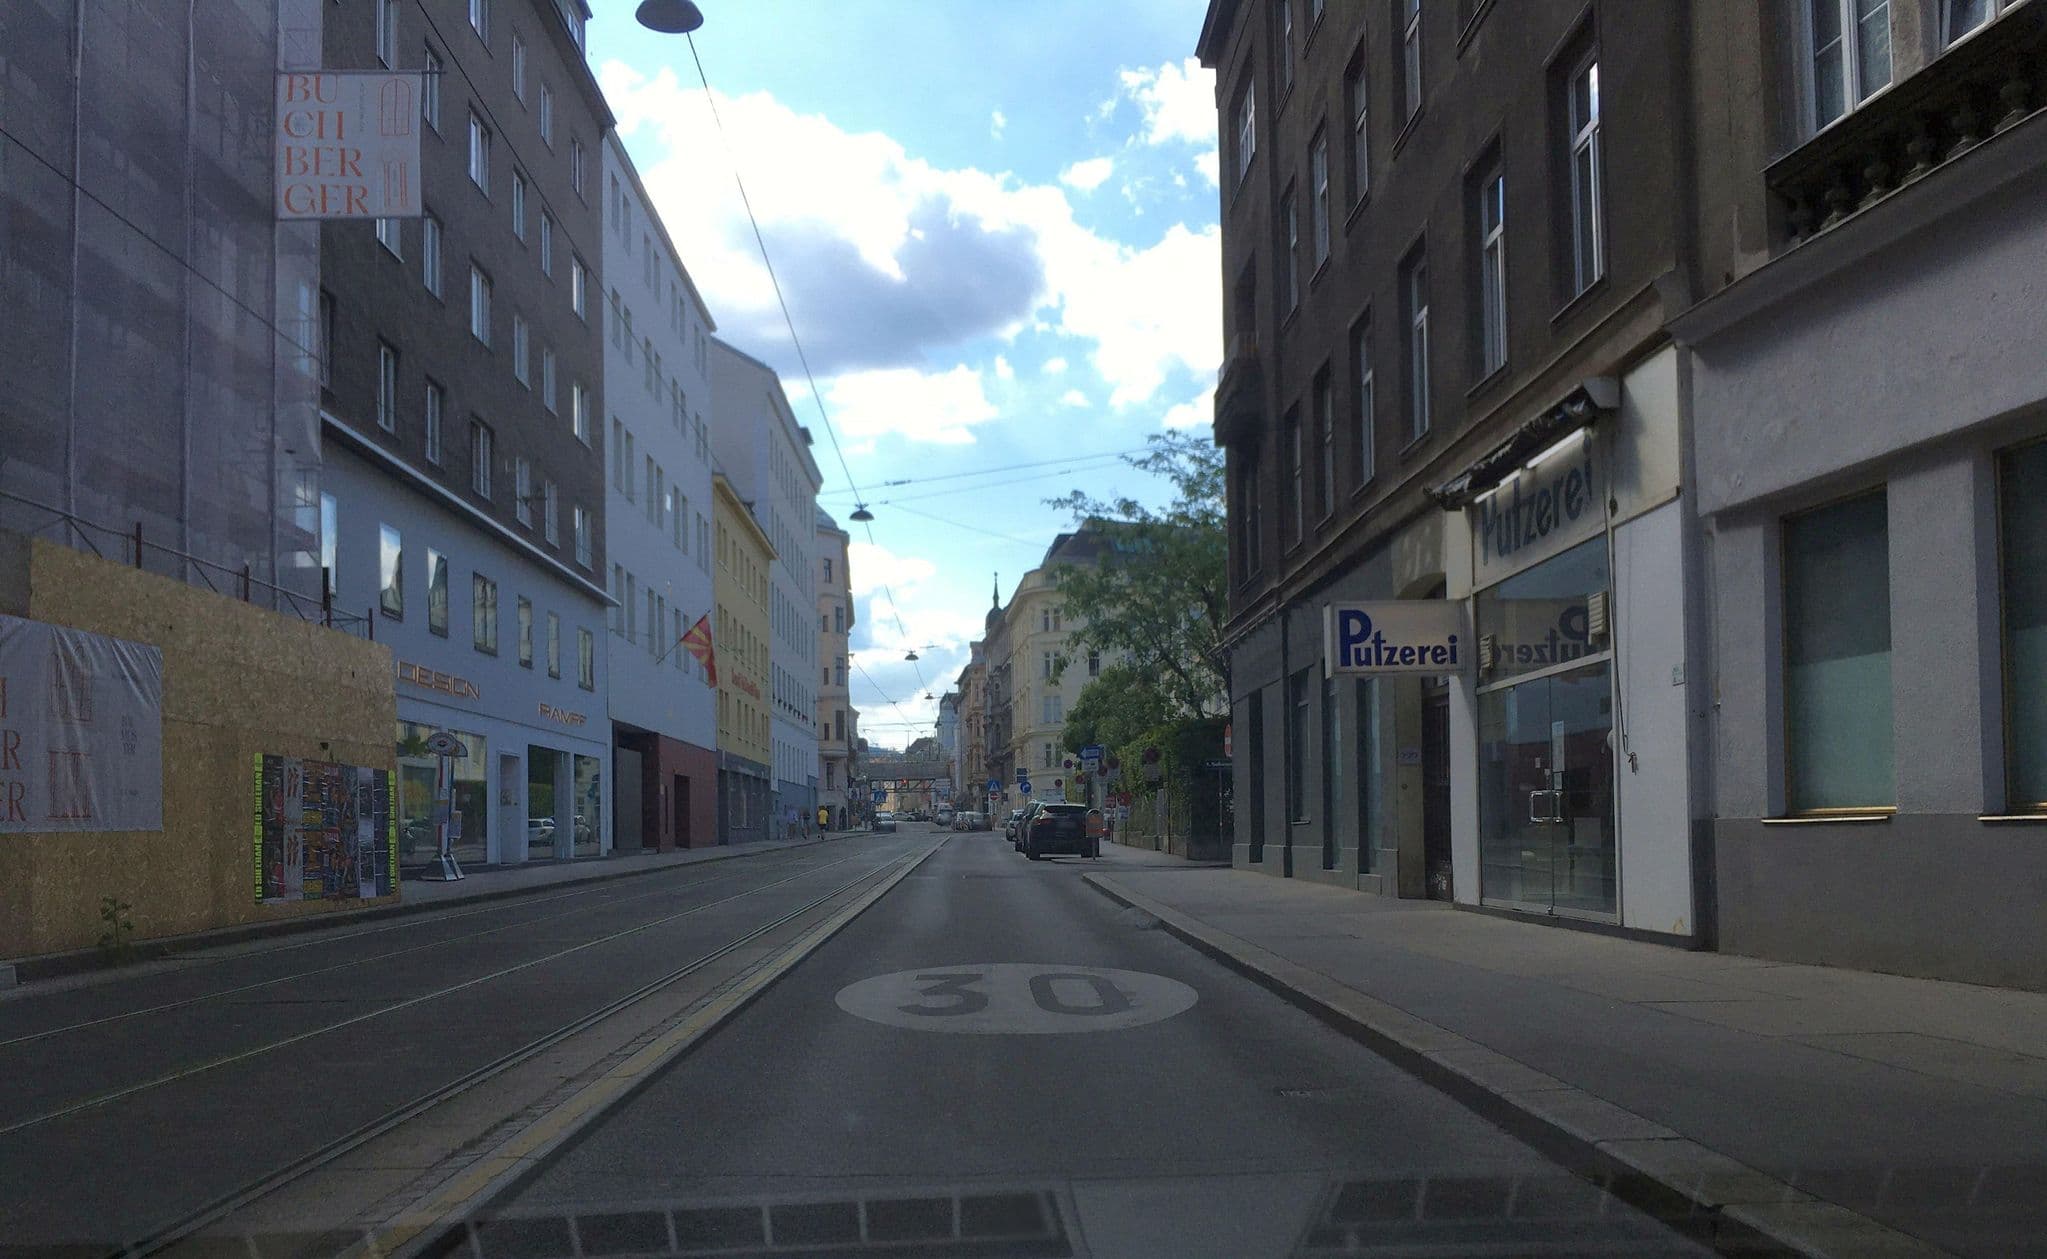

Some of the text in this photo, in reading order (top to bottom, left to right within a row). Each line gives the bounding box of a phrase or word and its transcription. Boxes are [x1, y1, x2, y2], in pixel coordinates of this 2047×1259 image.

[284, 145, 362, 177] BER
[284, 182, 369, 215] GER
[1339, 609, 1458, 667] Putzerei
[896, 974, 1132, 1016] 30
